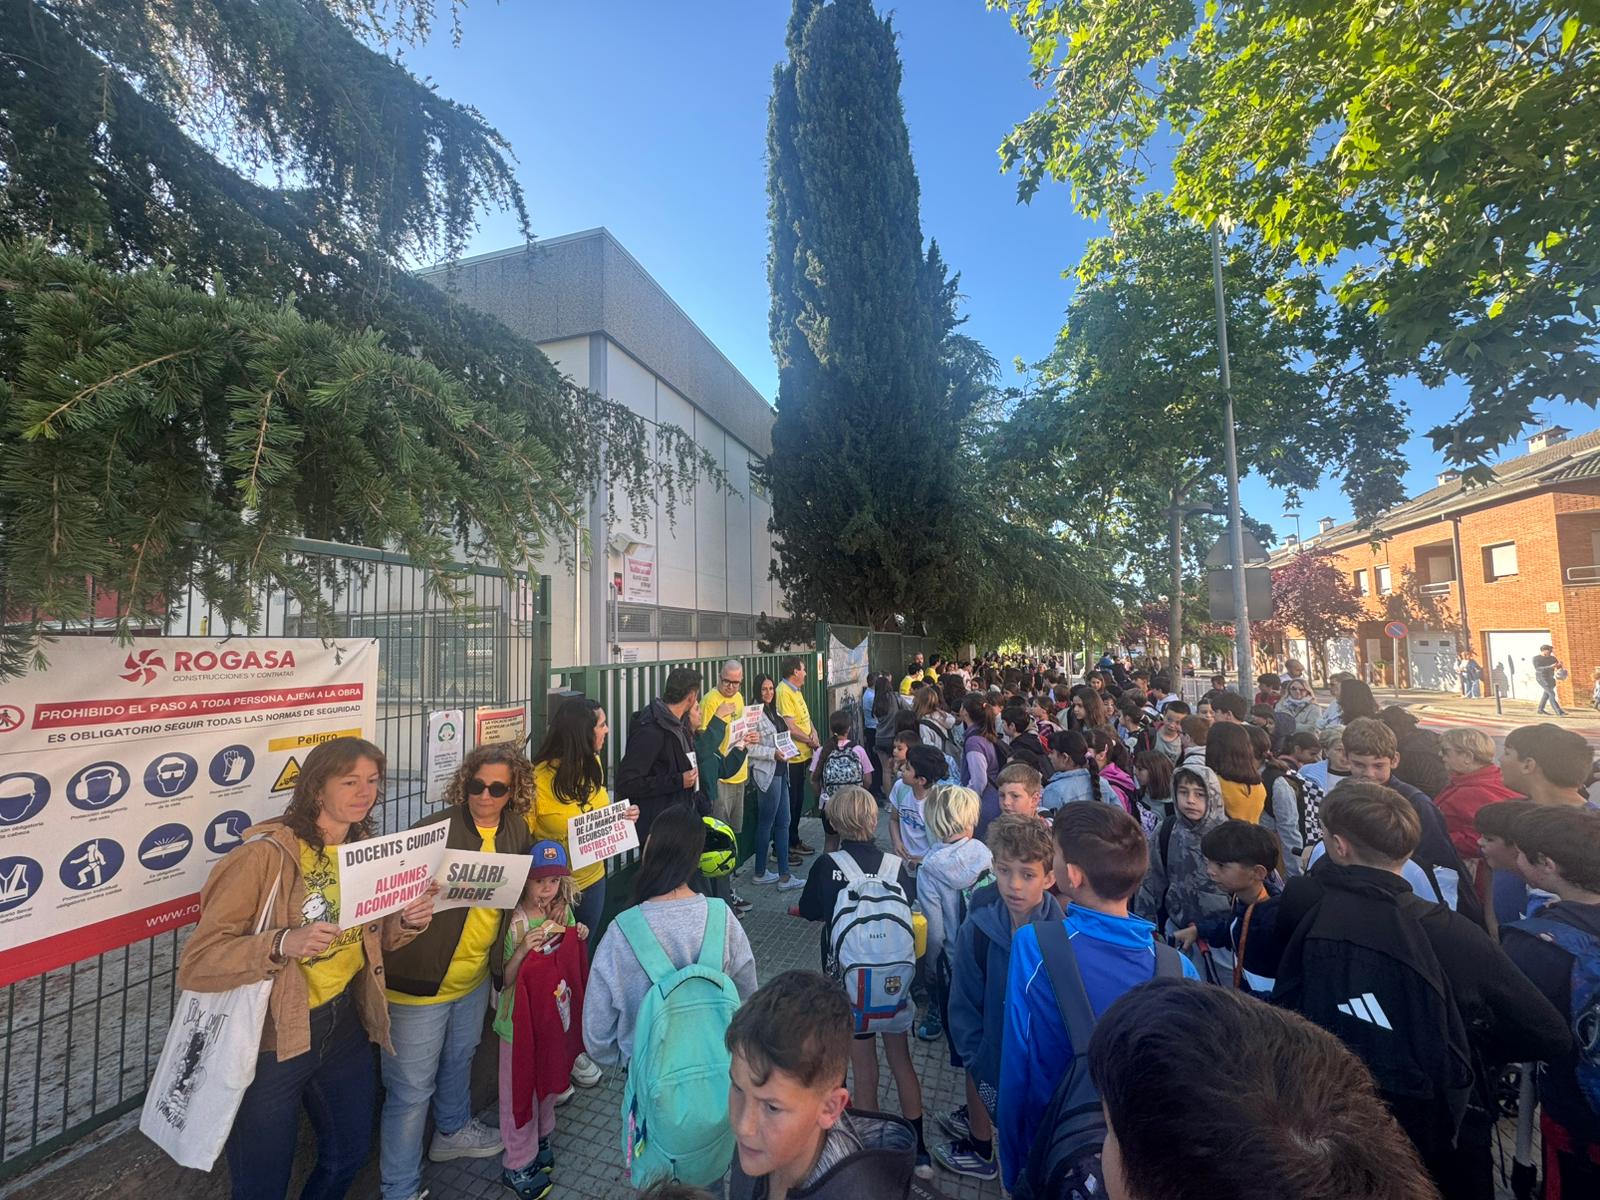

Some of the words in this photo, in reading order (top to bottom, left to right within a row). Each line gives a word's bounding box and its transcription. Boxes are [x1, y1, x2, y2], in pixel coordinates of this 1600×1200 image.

[174, 650, 296, 672] ROGASA
[173, 672, 249, 682] CONSTRUCCIONES
[39, 705, 125, 721] PROHIBIDO
[129, 704, 146, 715] EL
[150, 701, 187, 712] PASO
[189, 700, 198, 709] A
[201, 697, 231, 709] TODA
[233, 694, 284, 706] PERSONA
[286, 692, 316, 702] AJENA
[324, 690, 336, 698] LA
[338, 688, 361, 697] OBRA
[47, 733, 66, 743] ES
[70, 724, 162, 741] OBLIGATORIO
[164, 719, 204, 731] SEGUIR
[206, 716, 242, 727] TODAS
[244, 714, 264, 723] LAS
[266, 711, 302, 721] NORMAS
[303, 709, 314, 717] DE
[316, 705, 361, 715] SEGURIDAD
[297, 733, 338, 745] Peligro
[574, 818, 585, 827] QUI
[586, 811, 603, 823] PAGA
[603, 809, 610, 817] EL
[611, 802, 626, 815] PREU
[576, 827, 584, 836] DE
[585, 823, 594, 833] LA
[594, 816, 617, 831] MANCA
[617, 812, 625, 820] DE
[578, 826, 613, 845] RECURSOS?
[613, 821, 626, 832] ELS
[579, 837, 607, 855] VOSTRES
[607, 832, 624, 846] FILLS
[345, 839, 404, 867] DOCENTS
[406, 826, 446, 850] CUIDATS
[595, 844, 617, 860] FILLES!
[375, 864, 428, 895] ALUMNES
[447, 862, 505, 883] SALARI
[832, 869, 842, 881] FS
[447, 887, 496, 901] DIGNE
[146, 904, 200, 927] www.ro
